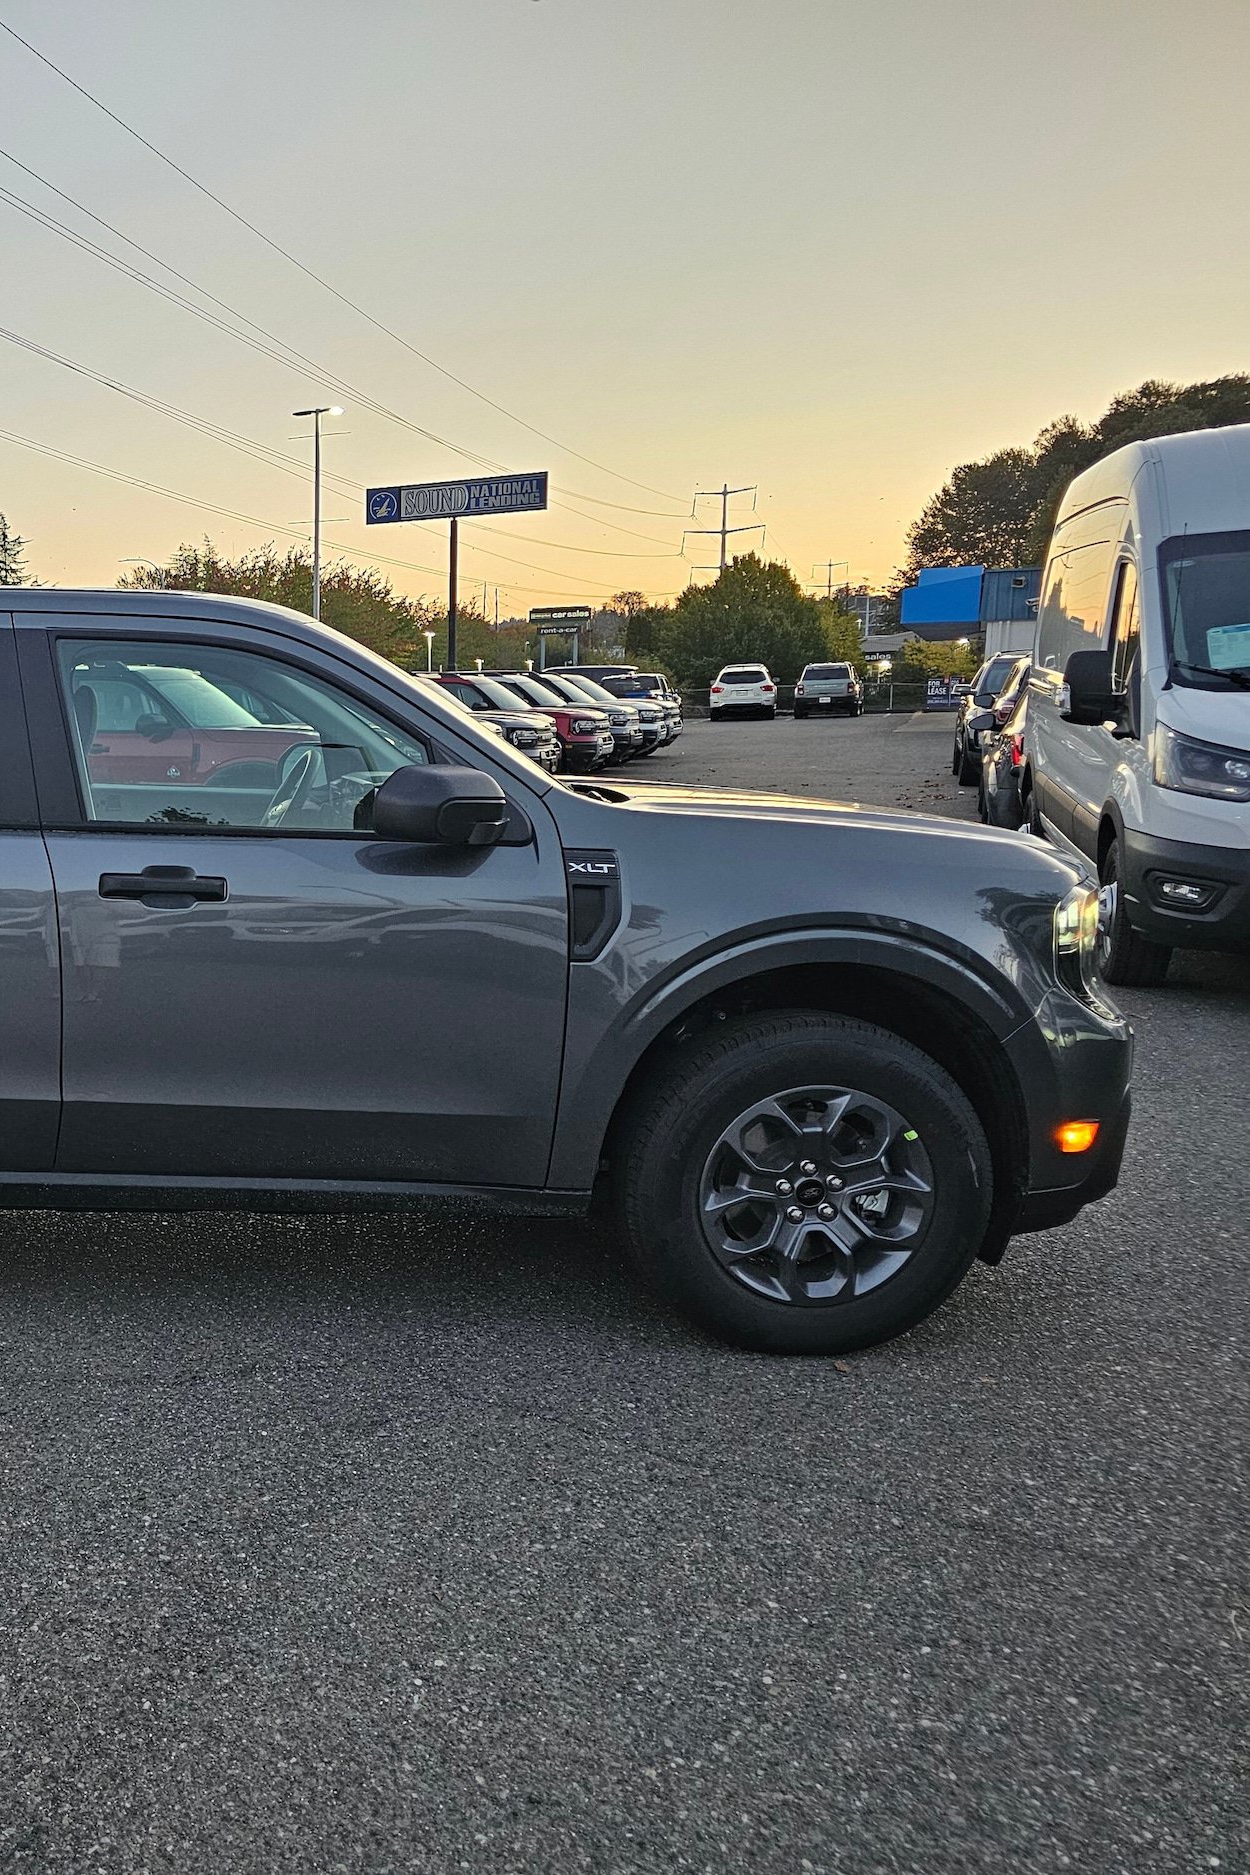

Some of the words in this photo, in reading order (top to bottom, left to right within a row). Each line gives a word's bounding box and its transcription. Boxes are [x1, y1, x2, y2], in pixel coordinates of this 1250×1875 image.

[471, 480, 540, 498] NATIONAL
[405, 487, 465, 516] SOUND
[471, 493, 540, 509] LENDING
[927, 687, 947, 695] LEASE
[568, 862, 616, 874] XLT
